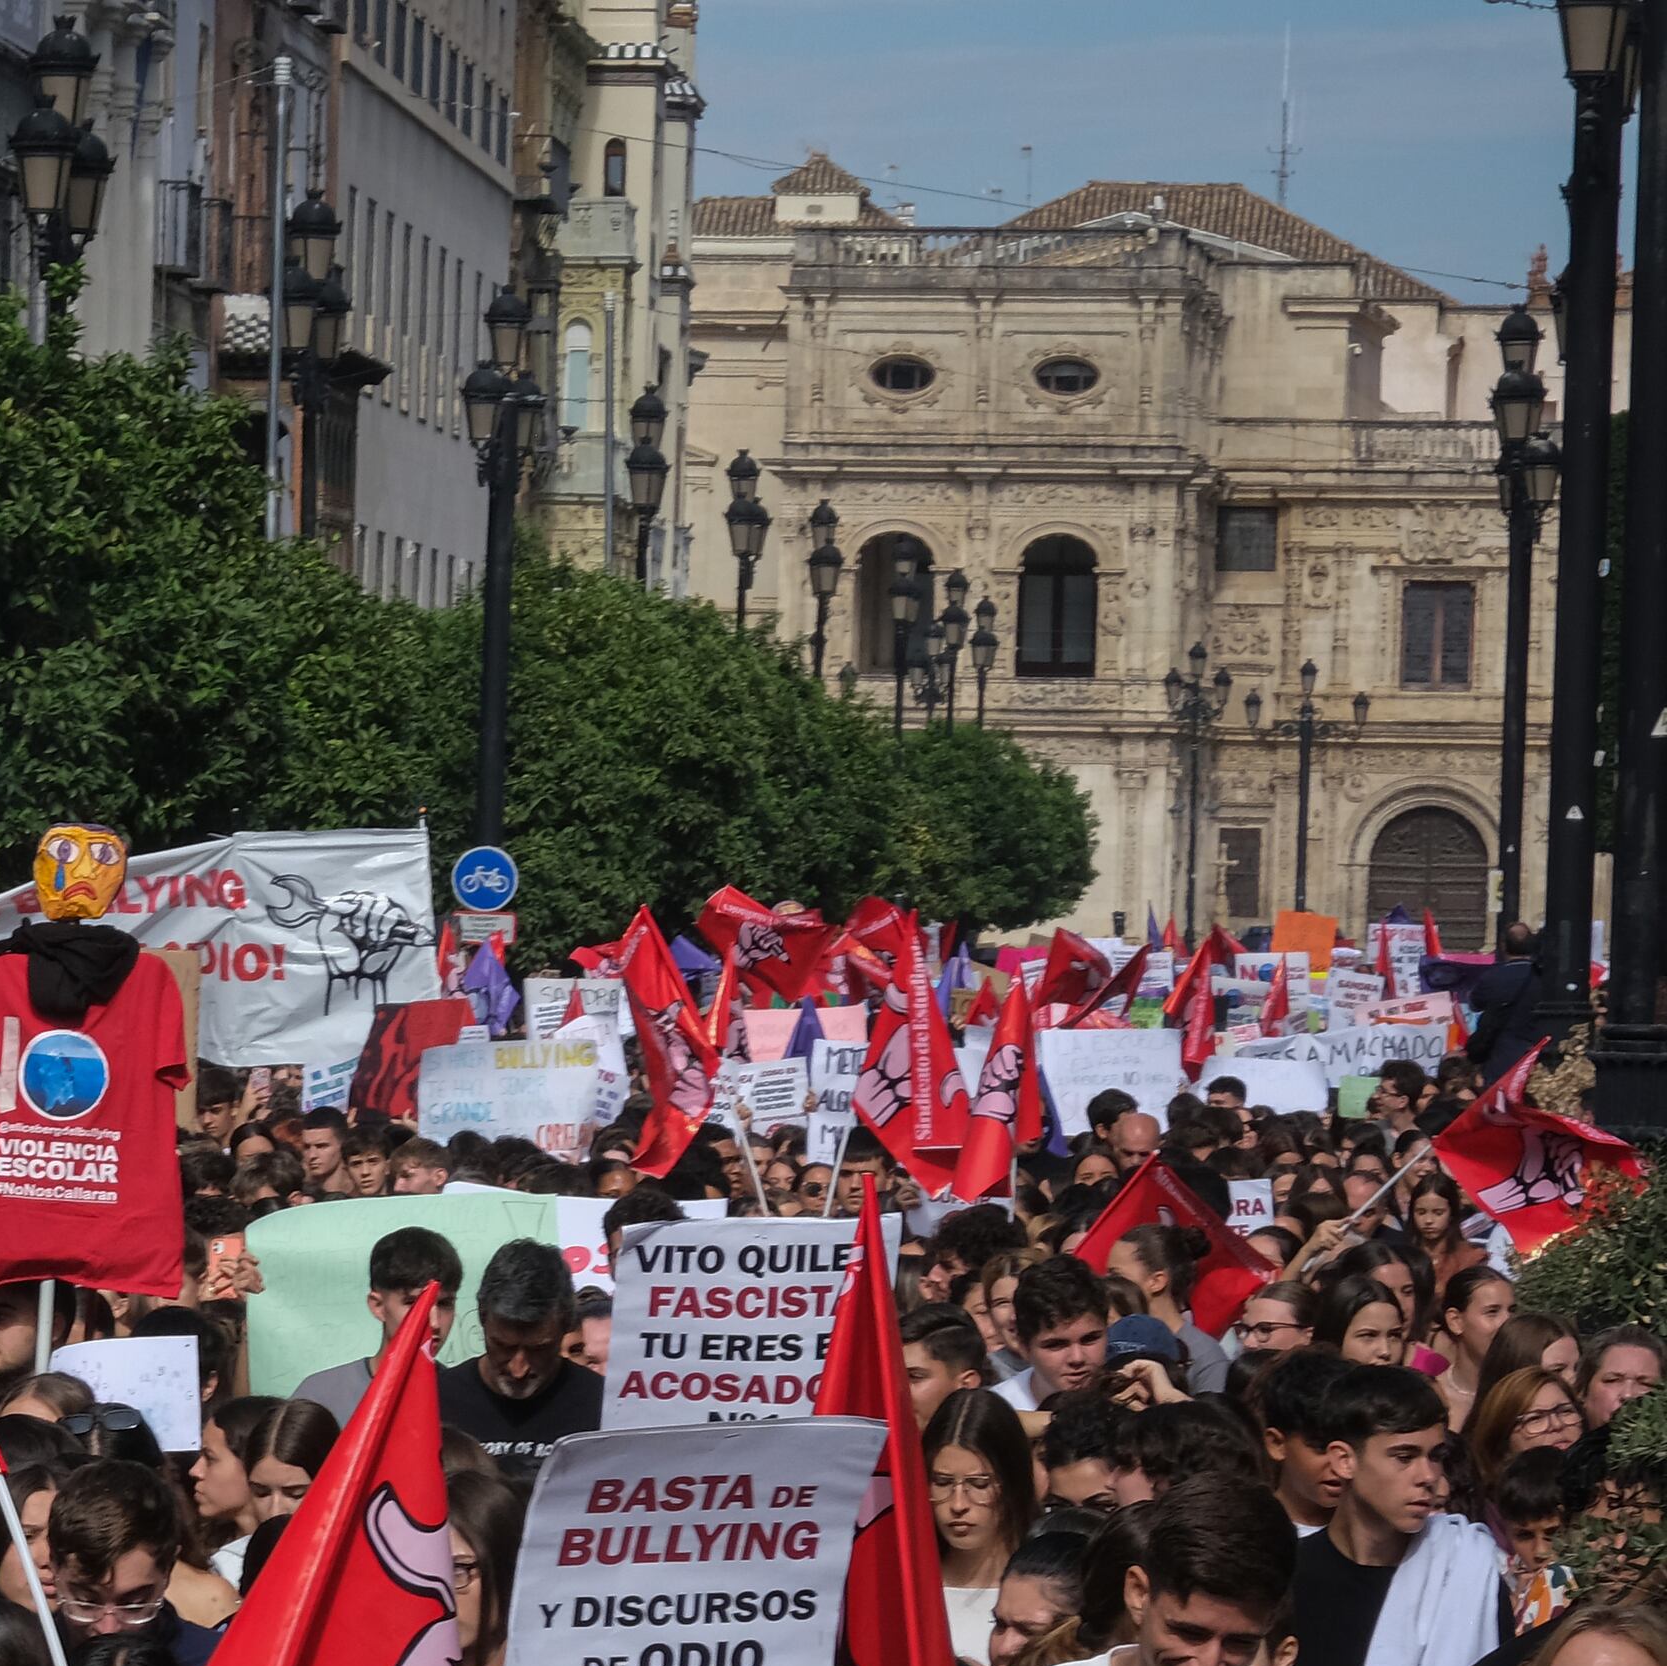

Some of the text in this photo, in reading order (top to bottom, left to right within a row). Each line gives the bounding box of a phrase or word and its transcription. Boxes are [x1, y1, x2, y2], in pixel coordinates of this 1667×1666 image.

[636, 1244, 726, 1275] VITO
[737, 1244, 853, 1279] QUILE
[639, 1332, 688, 1360] TU
[699, 1332, 804, 1362] ERES
[585, 1474, 819, 1514] BASTA DE
[556, 1520, 821, 1567] BULLYING
[539, 1589, 818, 1629] Y DISCURSOS
